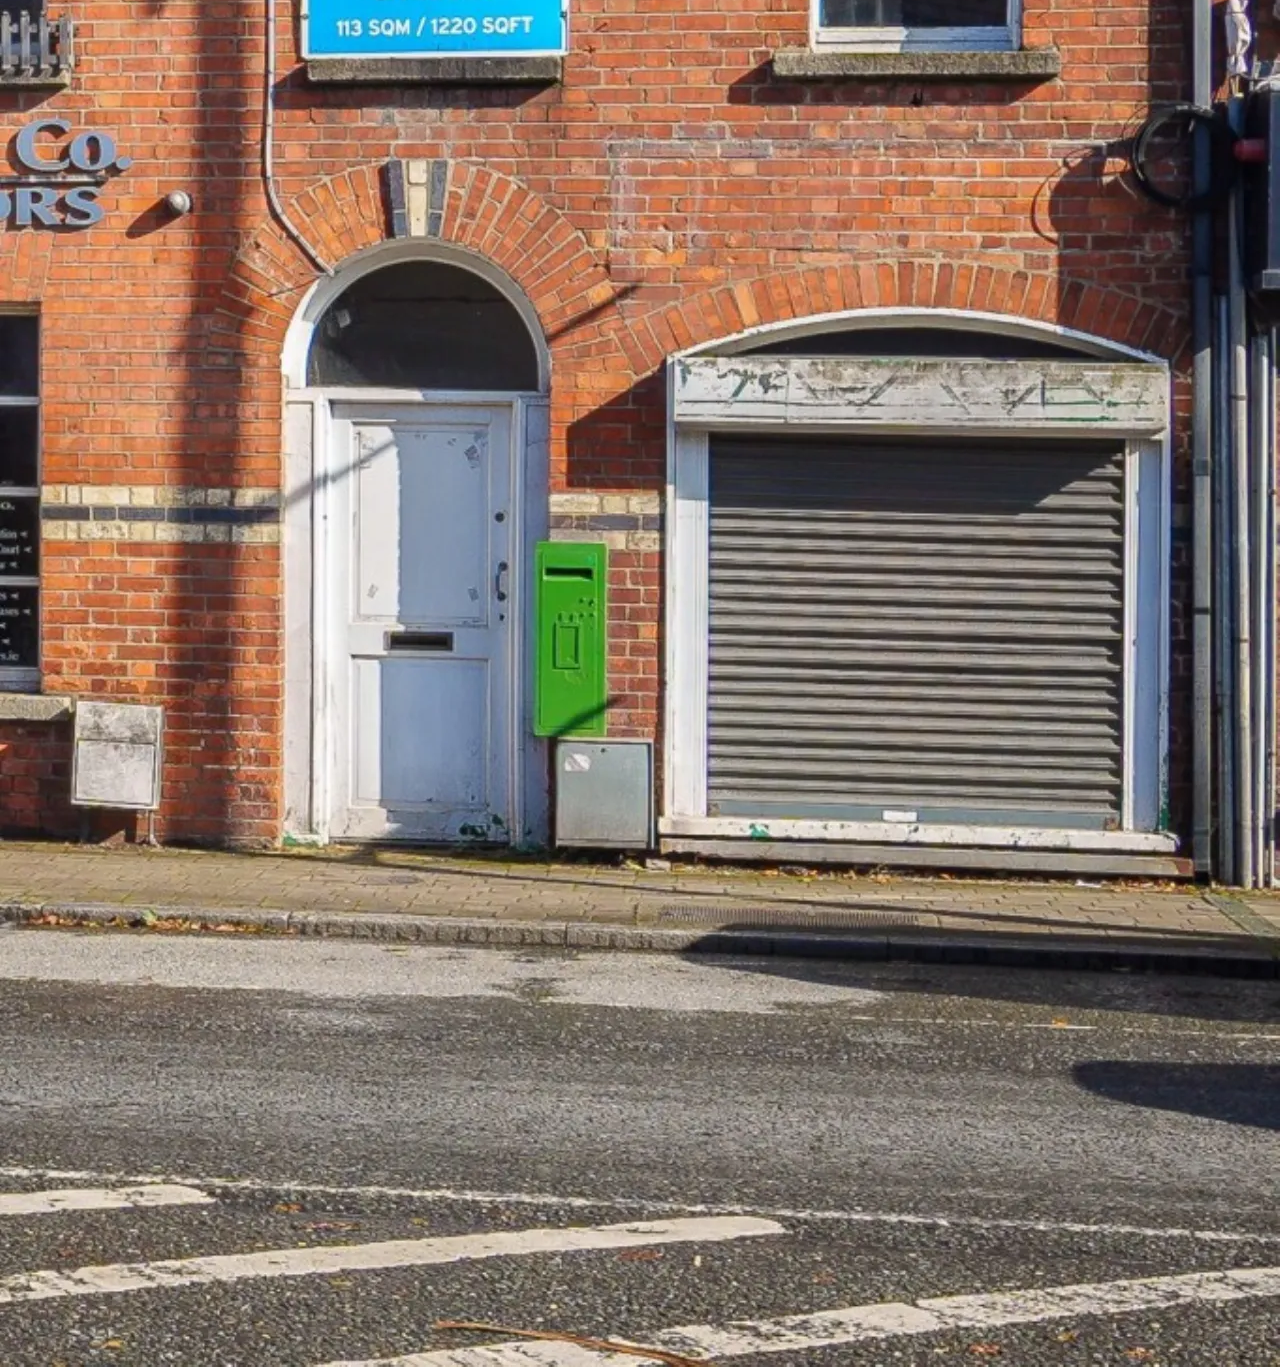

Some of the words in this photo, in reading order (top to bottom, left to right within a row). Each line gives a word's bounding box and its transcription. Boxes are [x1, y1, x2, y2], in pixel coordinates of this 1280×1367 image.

[336, 19, 363, 37] 113
[368, 18, 411, 37] SQM
[416, 17, 426, 37] /
[431, 17, 477, 35] 1220
[482, 15, 534, 34] SQFT
[16, 118, 133, 171] Co.
